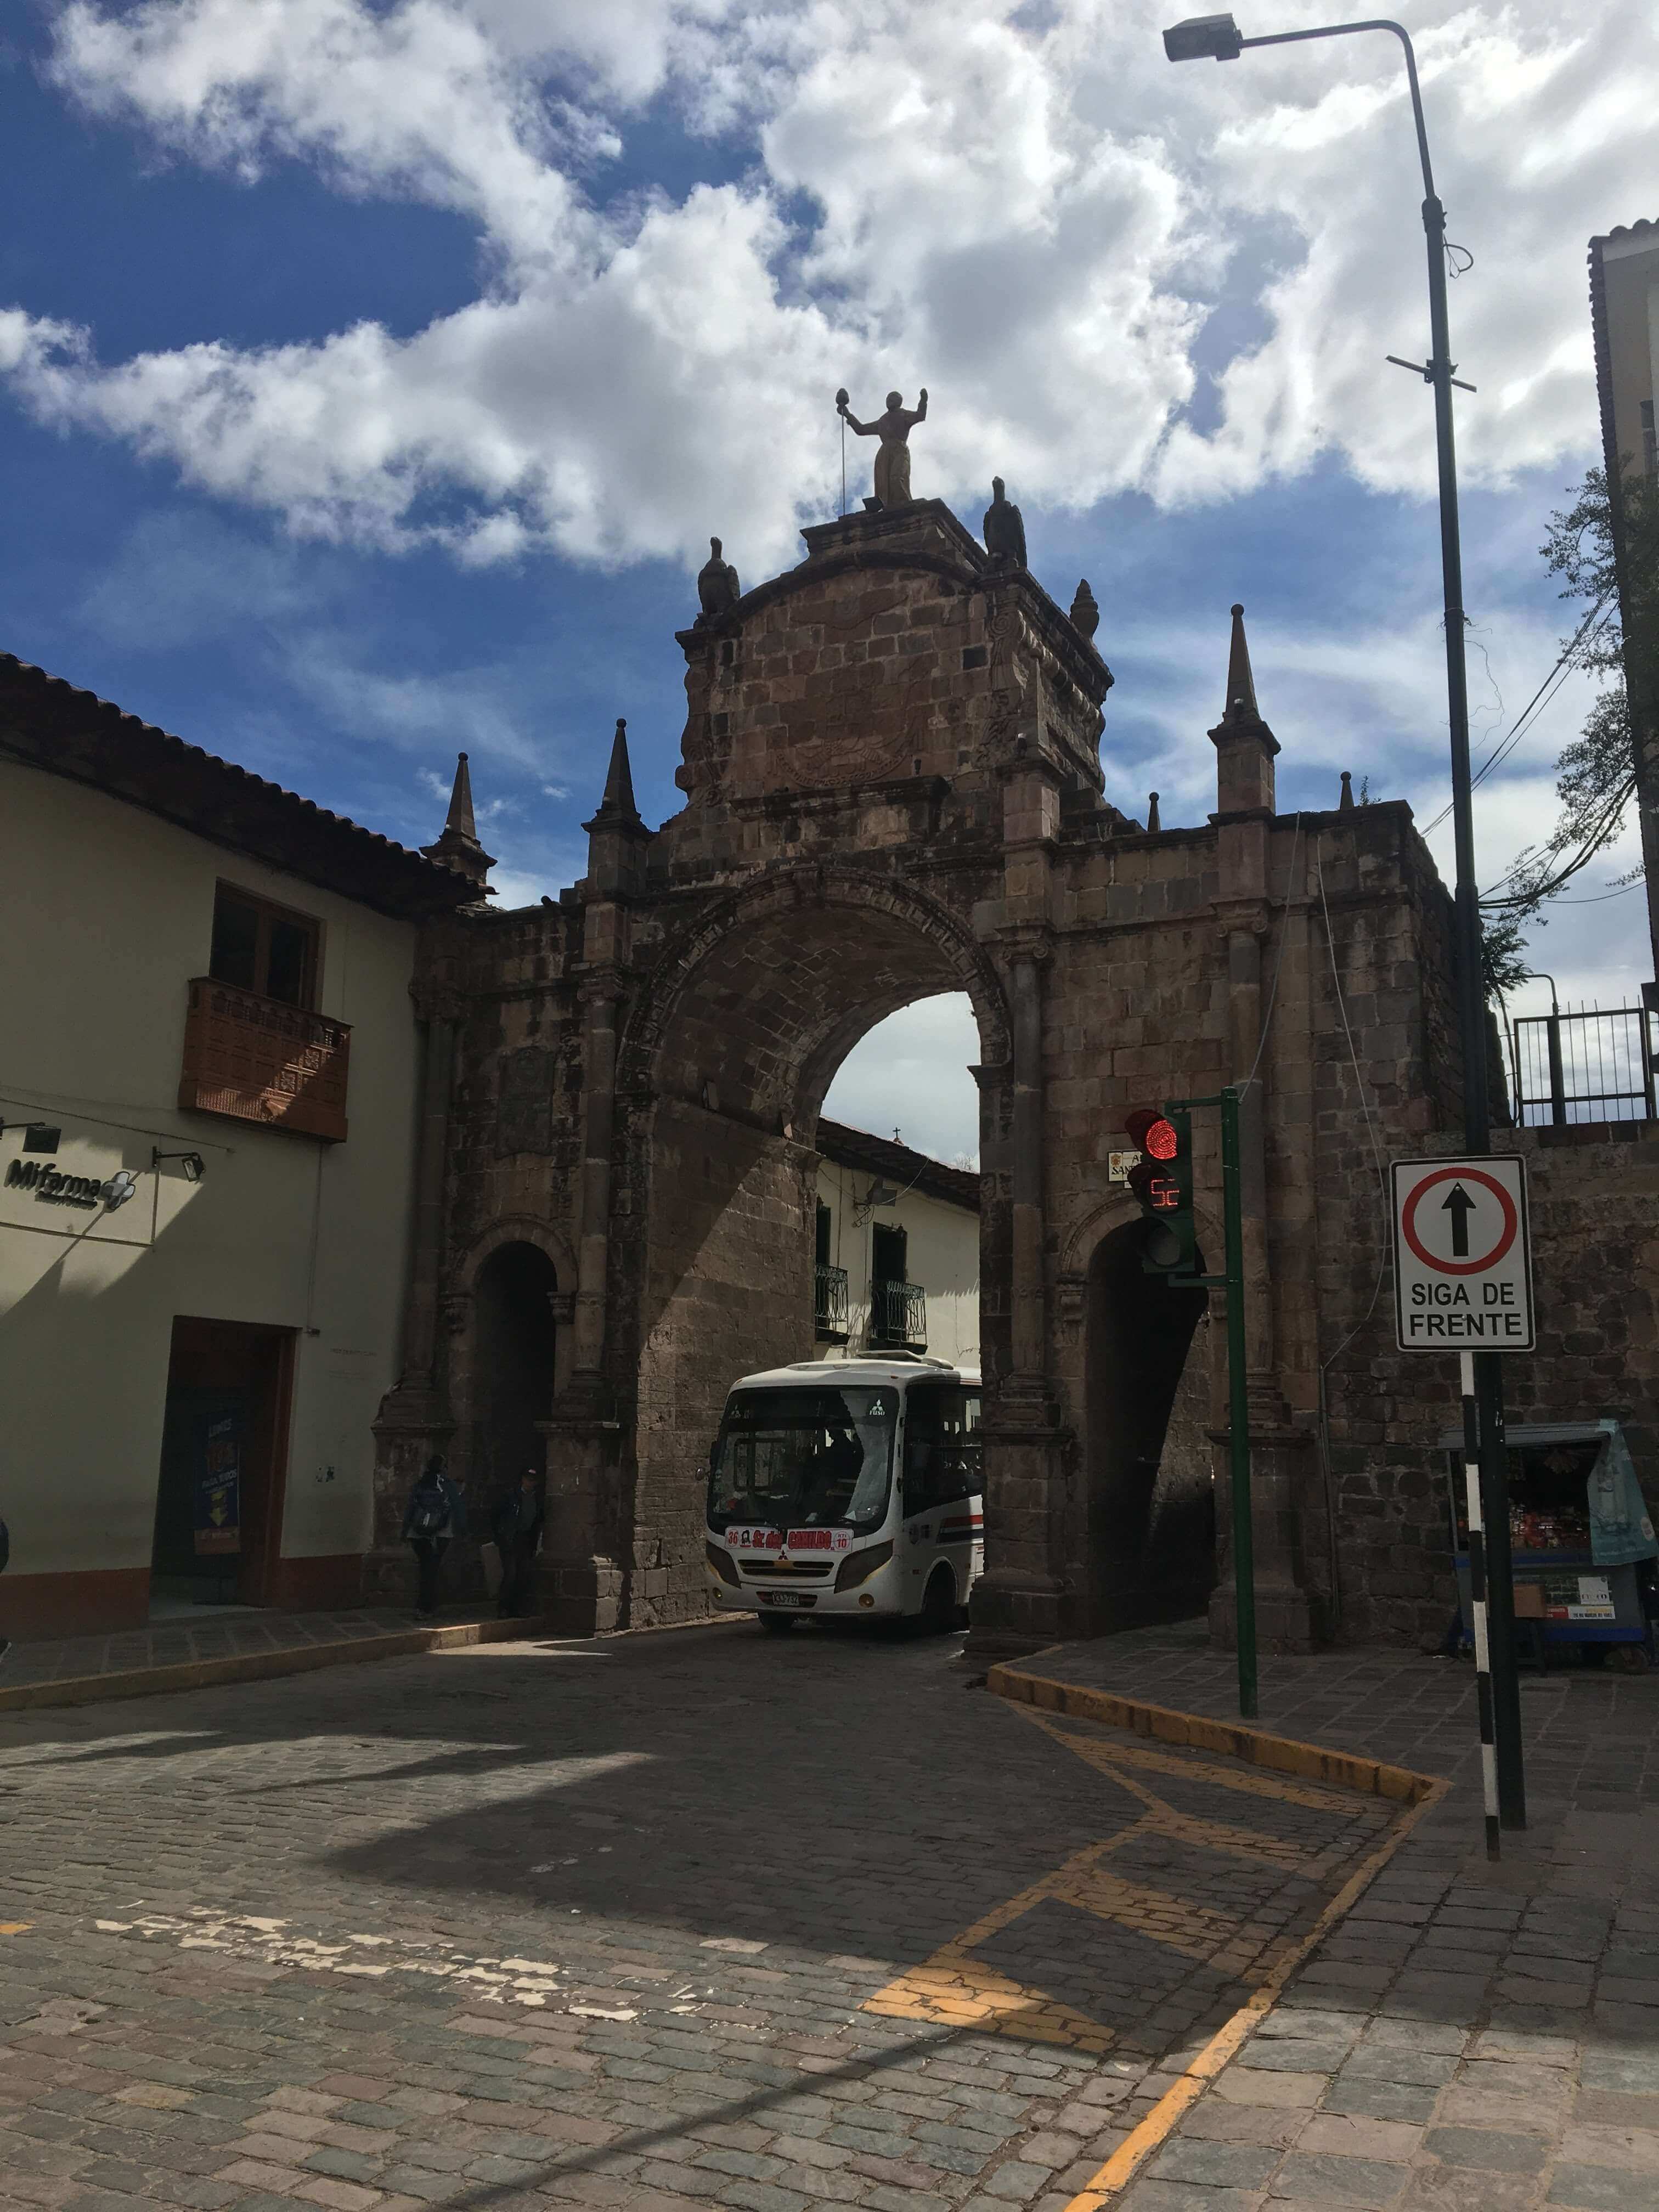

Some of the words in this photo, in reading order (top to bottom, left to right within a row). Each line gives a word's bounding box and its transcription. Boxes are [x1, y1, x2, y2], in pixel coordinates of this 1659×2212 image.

[7, 1159, 101, 1199] Mifarma
[1411, 1283, 1470, 1306] SIGA
[1483, 1283, 1514, 1305] DE
[1409, 1313, 1522, 1336] FRENTE
[729, 1531, 738, 1544] 36
[837, 1538, 847, 1548] 10
